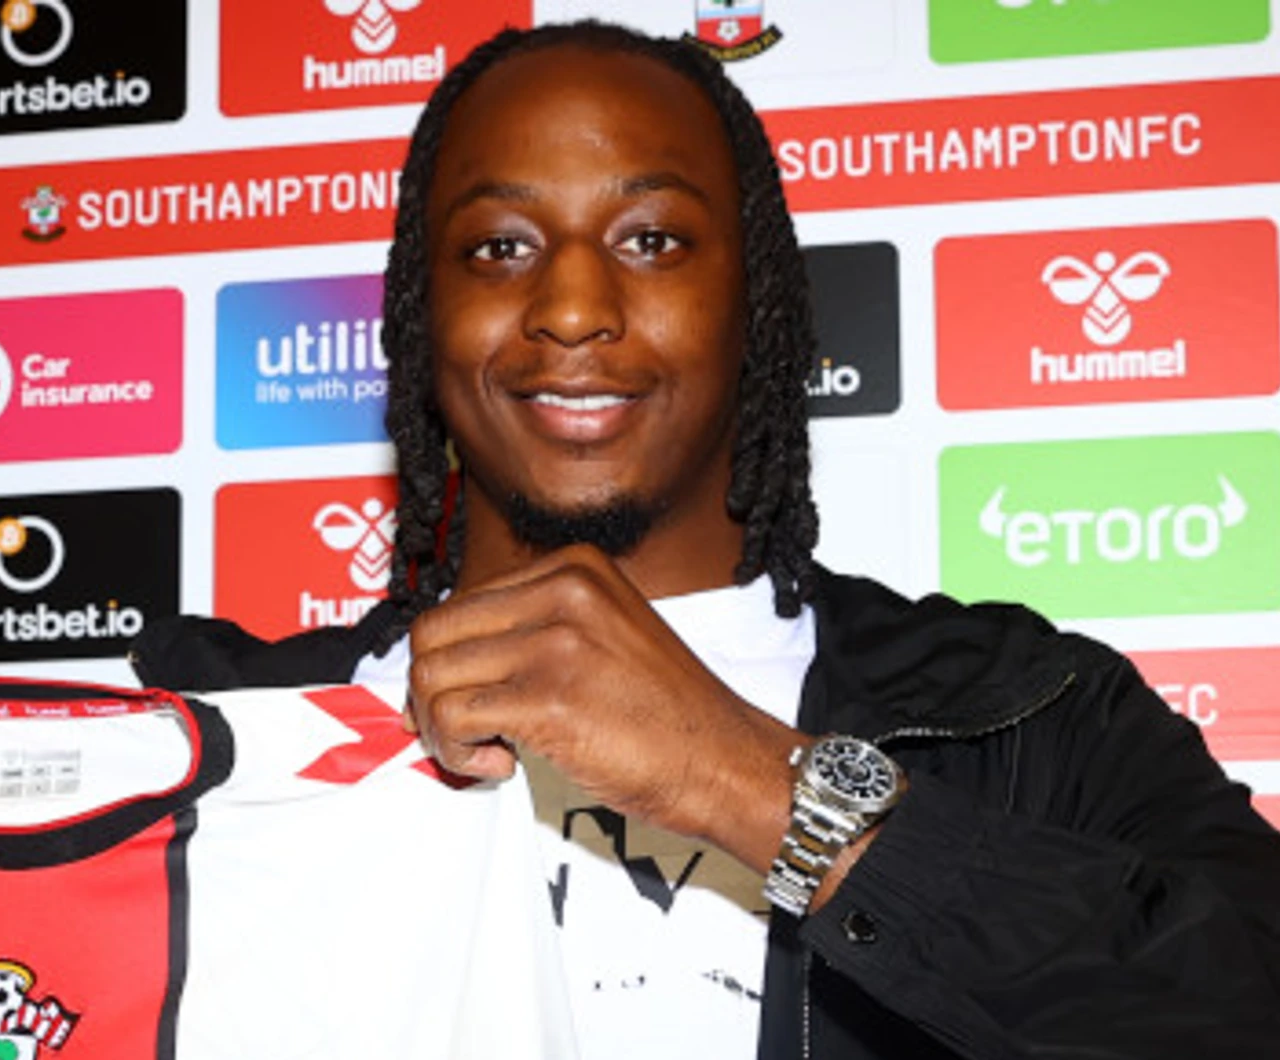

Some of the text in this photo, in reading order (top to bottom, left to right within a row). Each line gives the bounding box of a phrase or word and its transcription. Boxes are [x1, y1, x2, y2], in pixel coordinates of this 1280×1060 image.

[304, 42, 446, 90] hummel
[778, 113, 1200, 181] SOUTHAMPTONFC
[22, 354, 70, 380] Car
[1031, 338, 1186, 383] hummel
[21, 379, 153, 407] insurance
[295, 379, 347, 400] with
